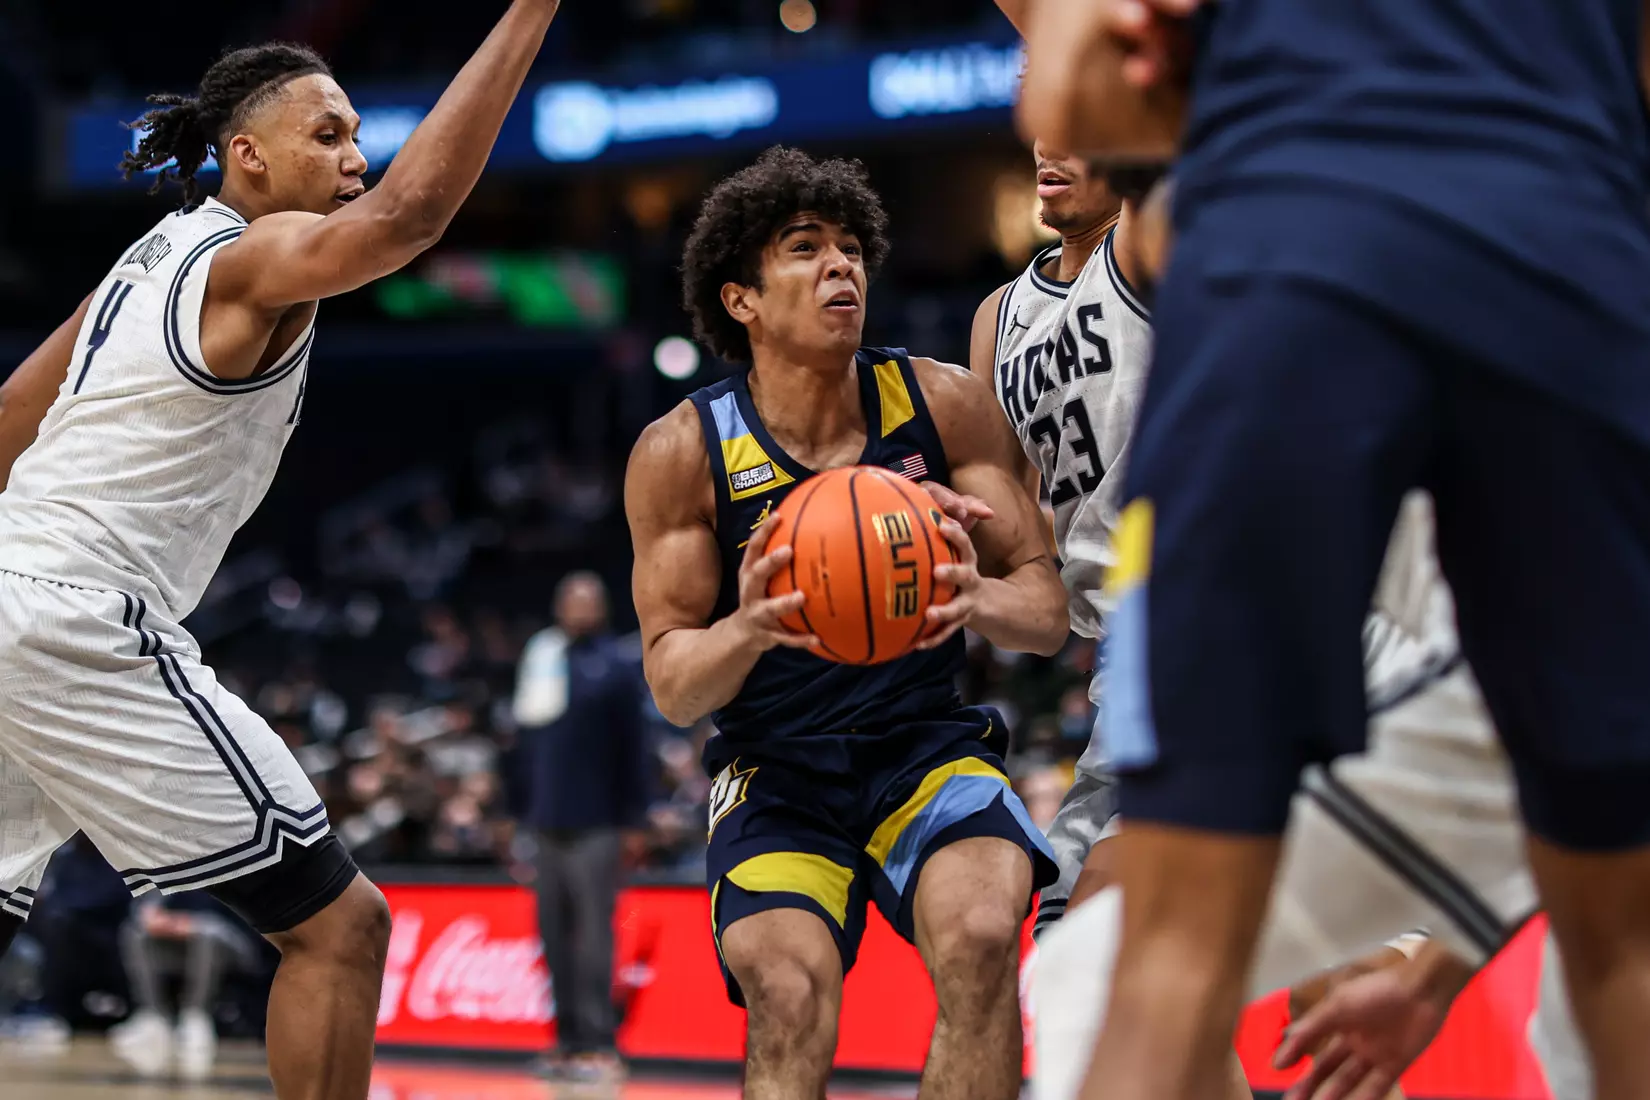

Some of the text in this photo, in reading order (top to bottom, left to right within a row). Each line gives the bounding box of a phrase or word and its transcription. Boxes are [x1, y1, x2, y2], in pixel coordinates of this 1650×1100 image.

[73, 277, 136, 396] 4
[734, 471, 774, 490] CHANGE
[1029, 397, 1105, 507] 23
[881, 511, 919, 619] ELITE
